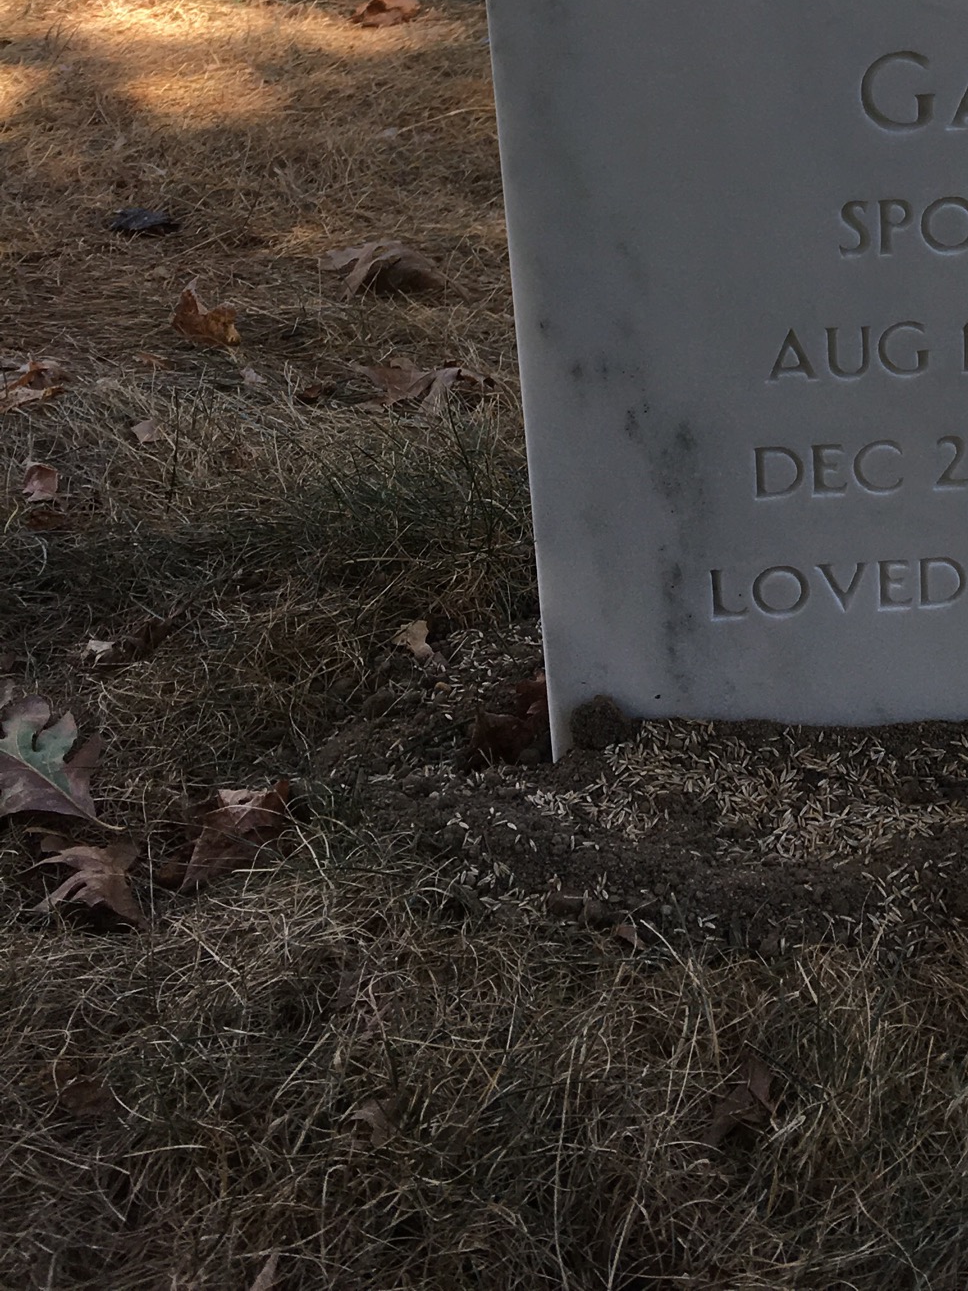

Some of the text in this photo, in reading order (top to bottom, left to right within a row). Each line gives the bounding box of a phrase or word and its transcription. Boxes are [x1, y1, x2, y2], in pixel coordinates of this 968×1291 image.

[766, 319, 930, 385] AUG
[752, 439, 904, 502] DEC
[708, 556, 968, 623] LOVED
